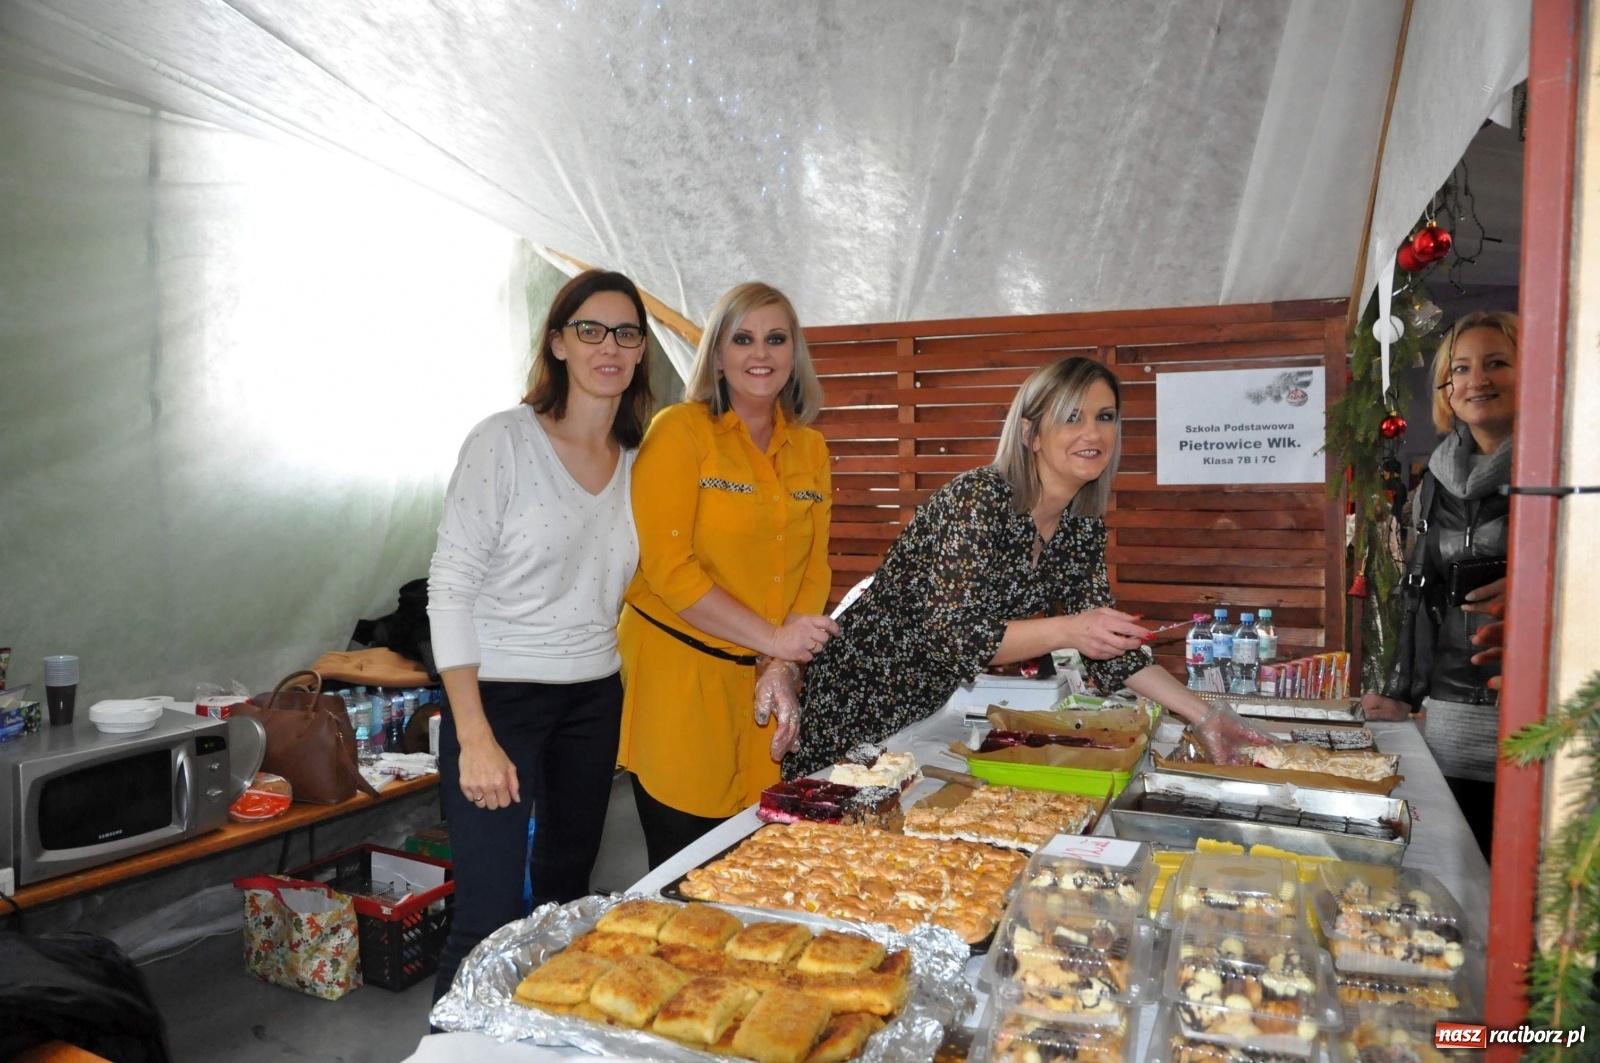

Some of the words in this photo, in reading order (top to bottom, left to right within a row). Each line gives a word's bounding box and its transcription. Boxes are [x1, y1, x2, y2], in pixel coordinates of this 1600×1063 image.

[1185, 424, 1220, 433] Szkoła
[1224, 423, 1295, 432] Podstawowa
[1179, 439, 1262, 451] Pietrowice
[1267, 437, 1301, 448] Wlk.
[1203, 456, 1234, 465] Klasa
[1237, 456, 1251, 464] 7B
[1261, 456, 1276, 464] 7C
